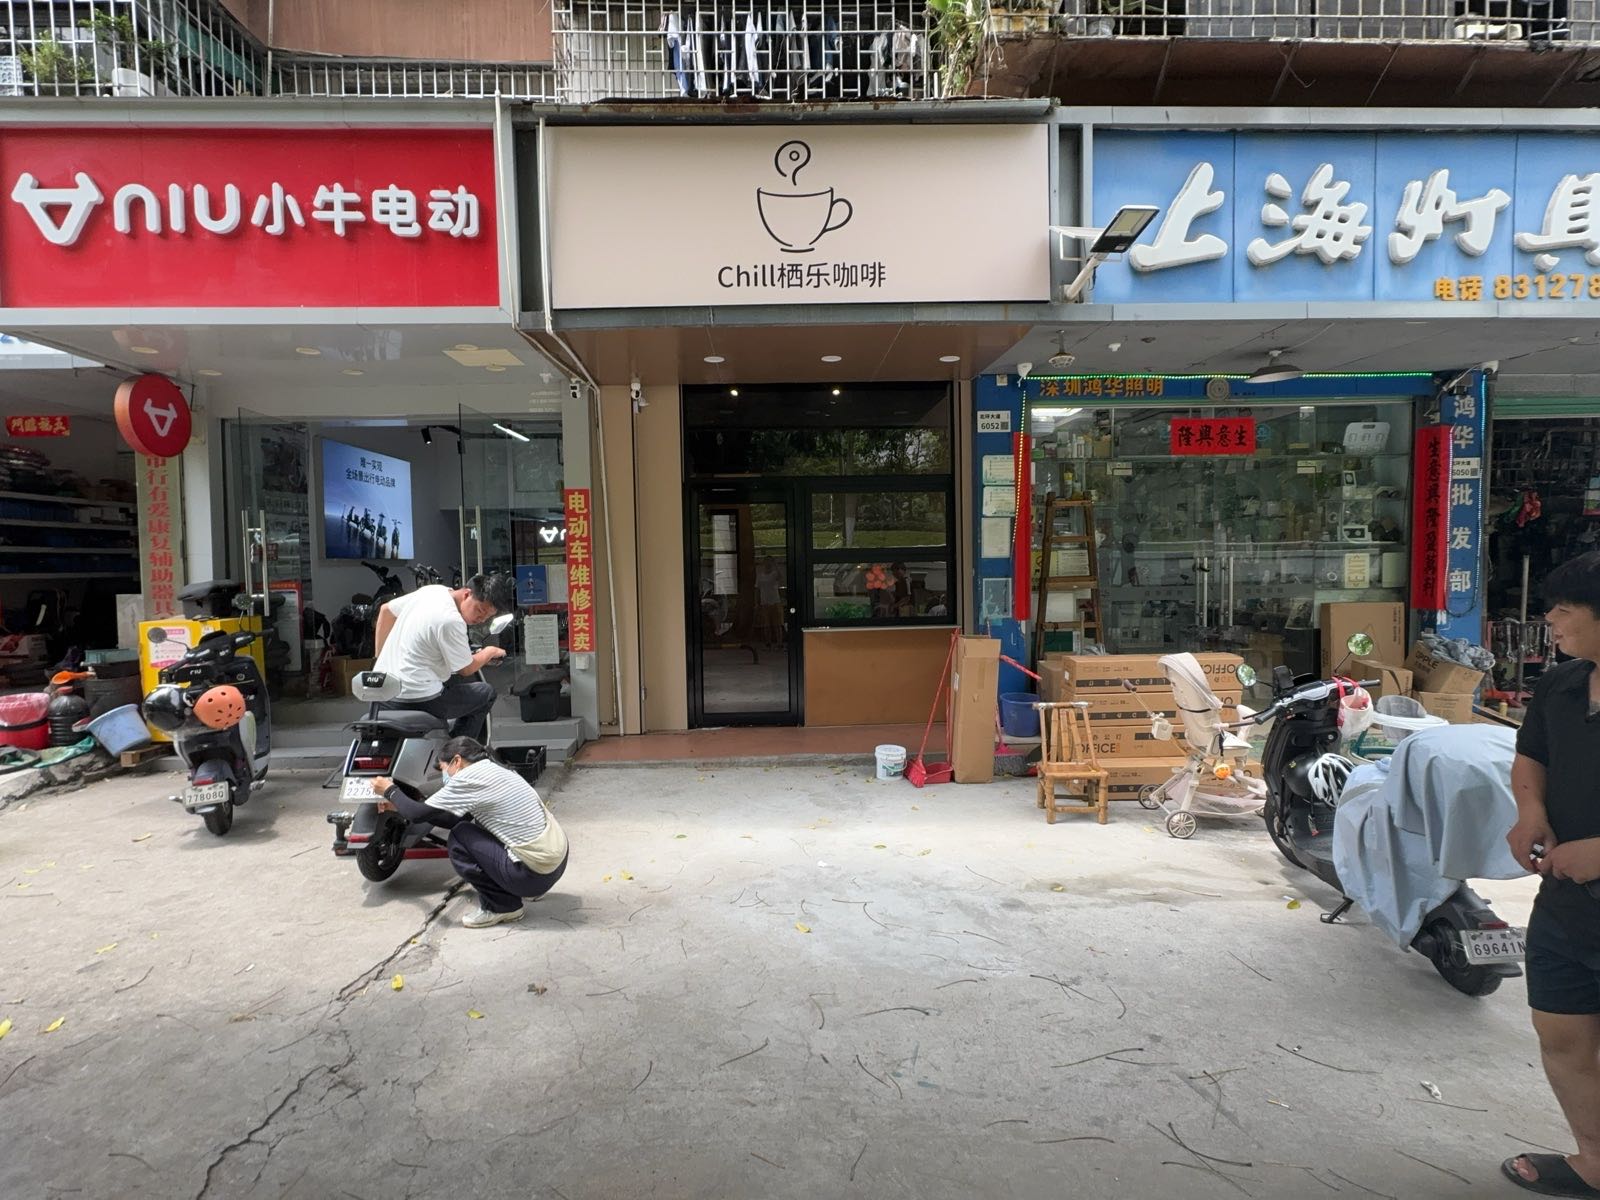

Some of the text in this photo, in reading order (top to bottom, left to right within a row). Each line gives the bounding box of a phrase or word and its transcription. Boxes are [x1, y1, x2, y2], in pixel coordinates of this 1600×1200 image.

[1129, 161, 1600, 273] 上海灯具
[717, 262, 887, 288] Chill栖乐咖啡
[1434, 276, 1482, 301] 电话
[1039, 379, 1164, 397] 深圳鸿华照明
[981, 422, 1000, 430] 6052
[568, 491, 591, 651] 电动车维修买卖
[1199, 663, 1236, 675] OFFIC
